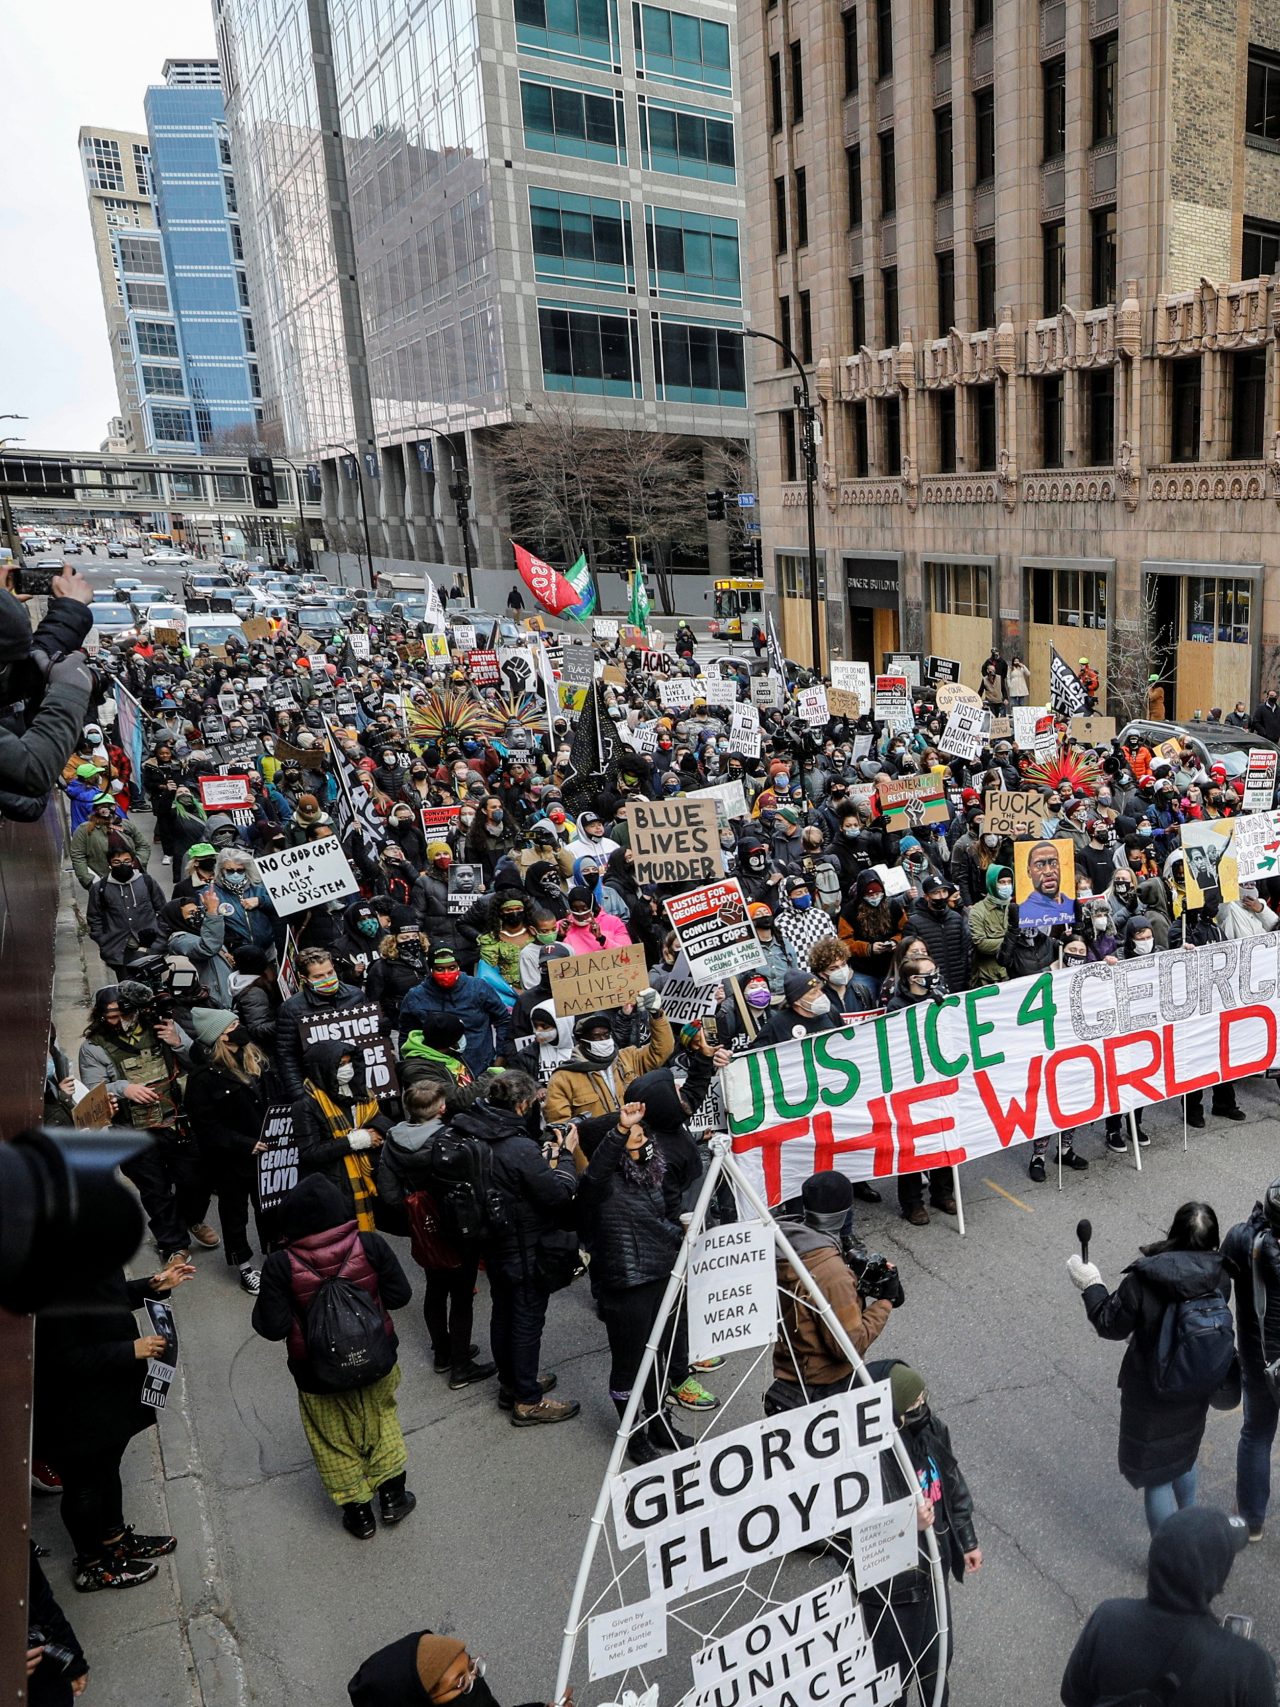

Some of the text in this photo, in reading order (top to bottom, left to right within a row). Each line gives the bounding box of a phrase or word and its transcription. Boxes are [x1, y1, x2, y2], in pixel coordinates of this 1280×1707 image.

[471, 654, 496, 662] JUSTICE
[642, 652, 670, 674] ACAB
[945, 686, 962, 694] YOUR
[1052, 657, 1088, 704] BLACK
[806, 698, 816, 706] FOR
[831, 698, 858, 710] SYSTEM
[939, 694, 978, 705] COP FRIENDS
[734, 703, 758, 719] JUSTICE
[801, 706, 827, 718] DAUNTE
[954, 702, 984, 722] JUSTICE
[1019, 708, 1041, 717] STOP
[742, 720, 752, 728] FOR
[960, 719, 972, 730] FOR
[636, 728, 658, 744] JUSTI
[732, 728, 758, 744] DAUNTE
[944, 726, 976, 746] DAUNTE
[730, 740, 758, 756] WRIGHT
[941, 738, 974, 757] WRIGHT
[888, 787, 937, 803] REST IN POWER
[990, 792, 1042, 818] FUCK
[634, 804, 706, 829] BLUE
[1002, 812, 1016, 820] THE
[635, 828, 709, 856] LIVES
[258, 840, 338, 874] NO GOOD COPS
[288, 869, 300, 880] IN
[637, 856, 716, 882] MURDER
[270, 876, 312, 900] RACIST
[297, 879, 346, 904] SYSTEM
[670, 886, 726, 912] JUSTICE FOR
[672, 892, 740, 920] GEORGE FLOYD
[682, 918, 722, 940] CONVICT
[688, 926, 749, 956] KILLER COPS
[561, 956, 620, 978] BLACK
[709, 960, 733, 973] KEUNG
[740, 950, 760, 960] THAO
[577, 973, 628, 996] LIVES
[664, 979, 719, 1002] DAUNTE
[564, 988, 635, 1015] MATTER
[306, 1015, 379, 1044] JUSTICE
[728, 973, 1056, 1136] JUSTICE 4
[732, 1080, 967, 1208] THE
[973, 1004, 1277, 1148] WORLD
[278, 1136, 289, 1146] FOR
[261, 1146, 300, 1171] GEORGE
[261, 1166, 298, 1196] FLOYD
[704, 1230, 752, 1252] PLEASE
[692, 1248, 766, 1276] VACCINATE
[708, 1284, 753, 1305] PLEASE
[704, 1303, 758, 1326] WEAR A
[711, 1323, 752, 1344] MASK
[150, 1363, 173, 1380] JUSTICE
[142, 1388, 166, 1407] FLOYD
[624, 1397, 884, 1530] GEORGE
[658, 1471, 870, 1590] FLOYD
[860, 1518, 894, 1534] ARTIST JOE
[860, 1532, 882, 1544] GEARY
[861, 1535, 896, 1553] TEAR DROP
[862, 1548, 885, 1562] DREAM
[862, 1555, 890, 1572] CATCHER
[612, 1612, 645, 1628] Given by
[698, 1580, 844, 1673] "LOVE"
[602, 1628, 630, 1642] Tiffany,
[604, 1630, 652, 1652] Great Auntie
[608, 1642, 648, 1661] Mel, & Joe
[696, 1612, 856, 1707] "UNITY"
